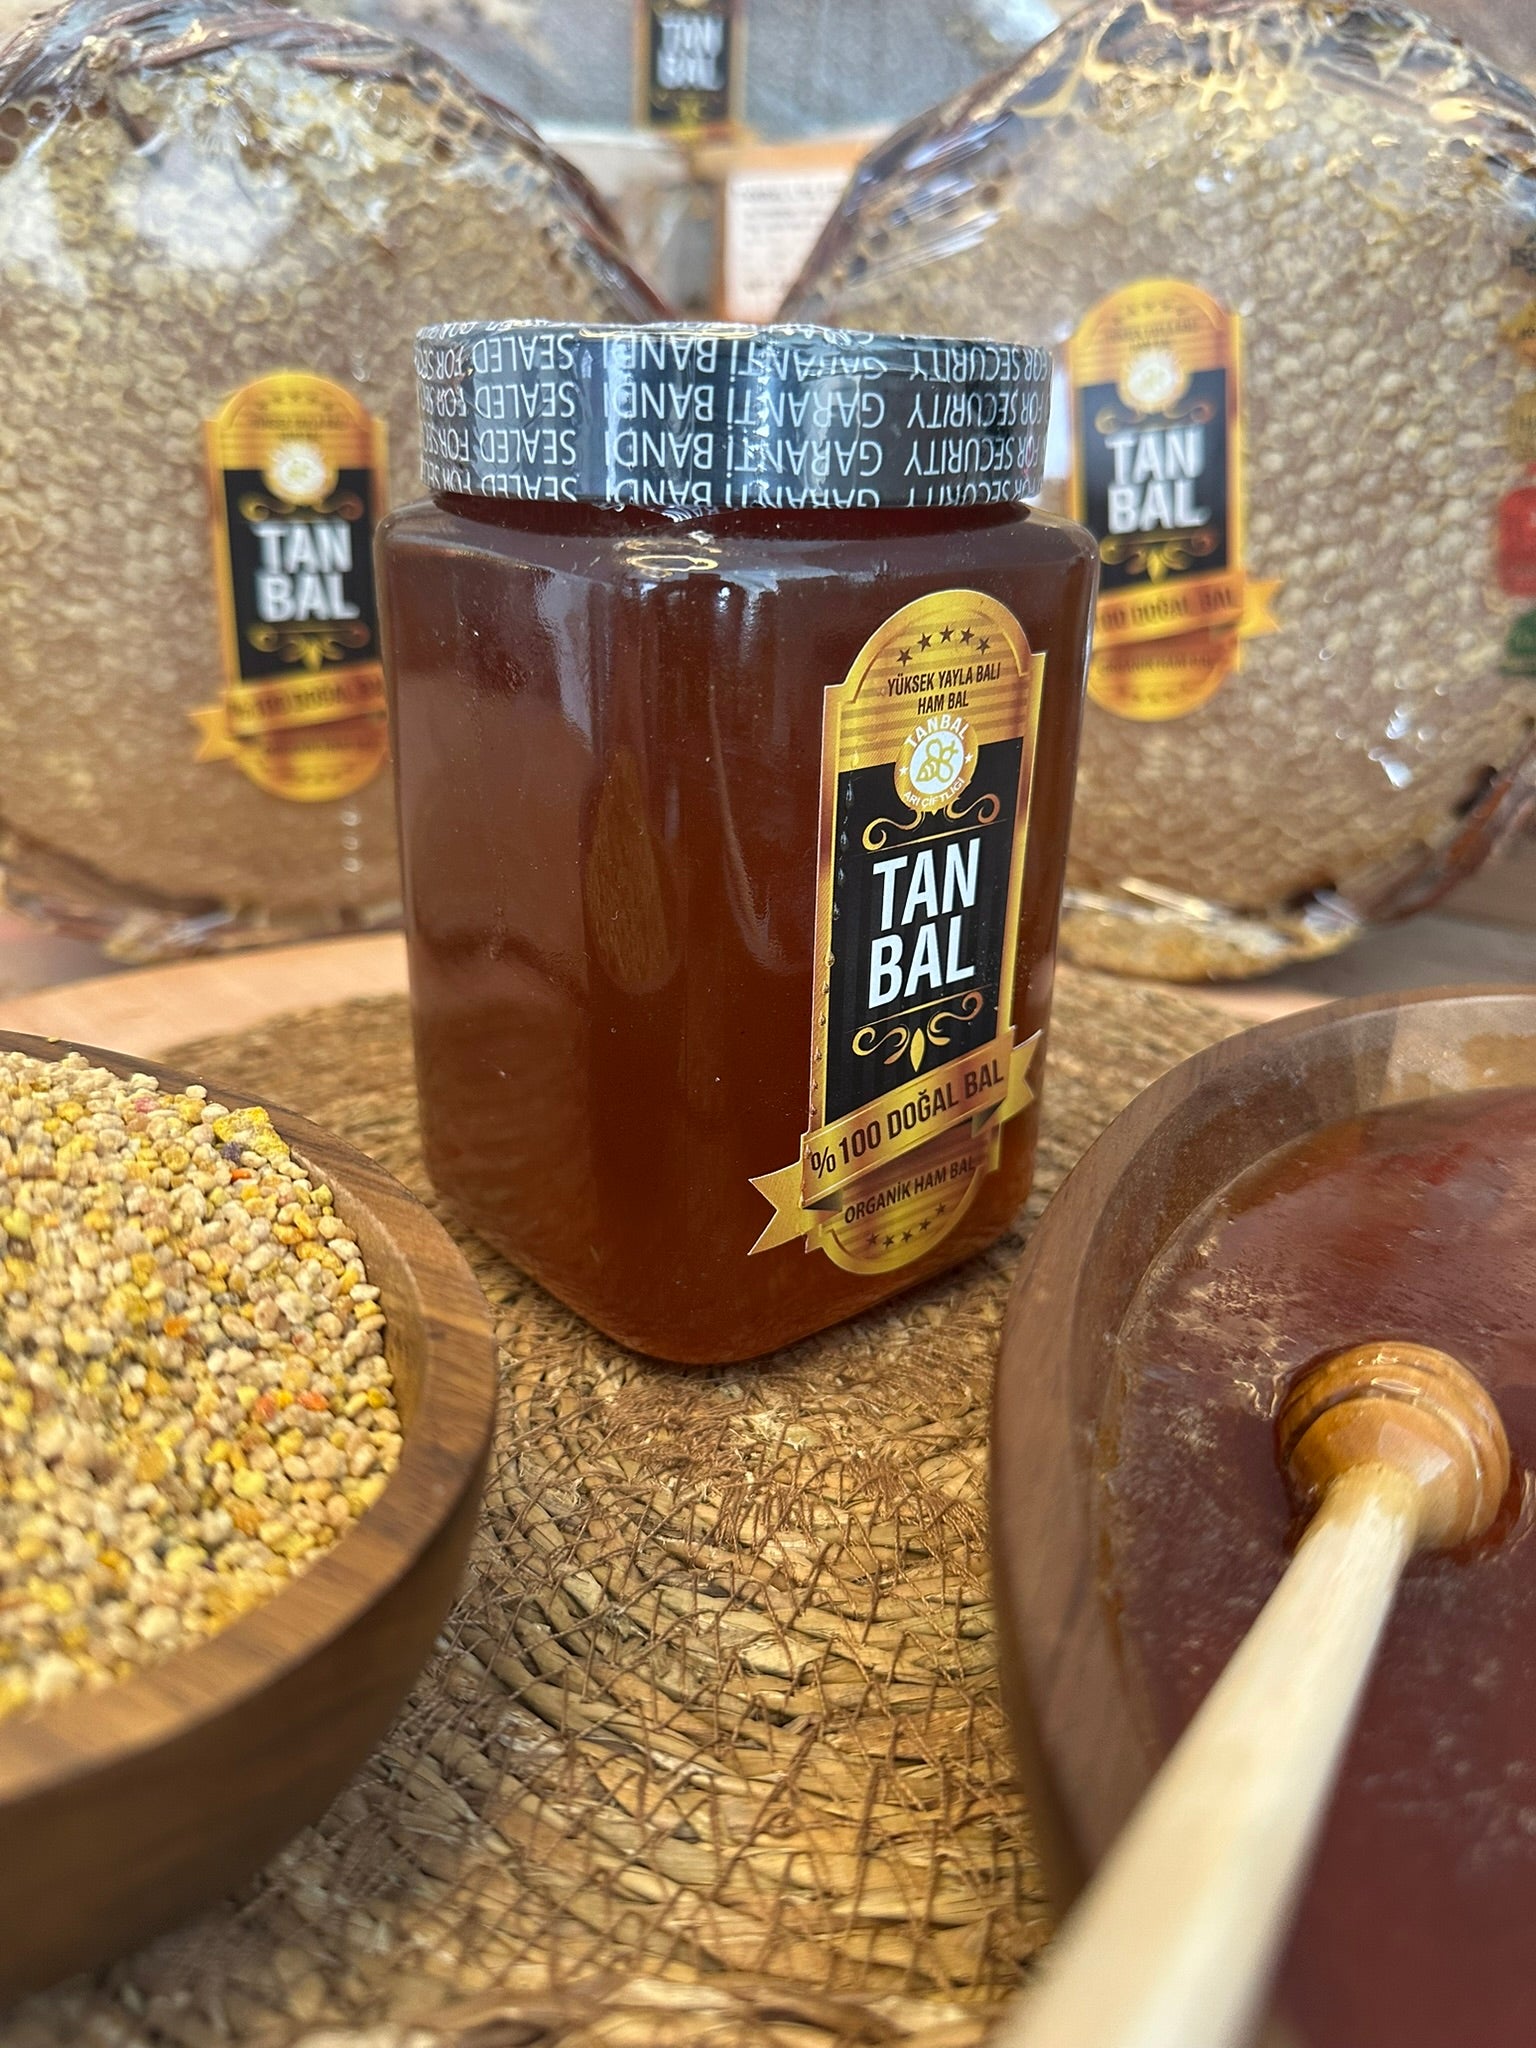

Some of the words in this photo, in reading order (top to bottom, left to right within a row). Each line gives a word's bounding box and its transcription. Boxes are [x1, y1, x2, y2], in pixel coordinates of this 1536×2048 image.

[436, 346, 464, 380] FOR
[472, 333, 576, 375] SEALED
[602, 335, 718, 374] BANDI
[1023, 348, 1049, 382] FOR
[436, 384, 467, 419] FOR
[474, 380, 577, 420] SEALED
[603, 383, 715, 423] BANDI
[726, 387, 886, 432] GARANTİ
[906, 389, 1019, 429] SECURITY
[1020, 390, 1046, 426] FOR
[438, 428, 470, 462] FOR
[479, 428, 578, 467] SEALED
[604, 431, 715, 470] BANDI
[726, 434, 884, 479] GARANTİ
[903, 436, 1015, 478] SECURITY
[1017, 434, 1041, 470] FOR
[1105, 425, 1207, 486] TAN
[1107, 477, 1212, 535] BAL
[254, 521, 354, 575] TAN
[256, 571, 361, 624] BAL
[888, 672, 936, 697] YÜKSEK
[938, 666, 974, 689] YAYLA
[976, 662, 1001, 684] BALI
[917, 694, 945, 716] HAM
[947, 690, 970, 710] BAL
[903, 713, 970, 748] TANBAL
[872, 837, 981, 932] TAN
[868, 914, 976, 1010] BAL
[886, 1082, 960, 1140] DOĞAL
[963, 1058, 1005, 1100] BAL
[844, 1180, 912, 1225] ORGANİK
[913, 1167, 948, 1196] HAM
[949, 1154, 977, 1181] BAL
